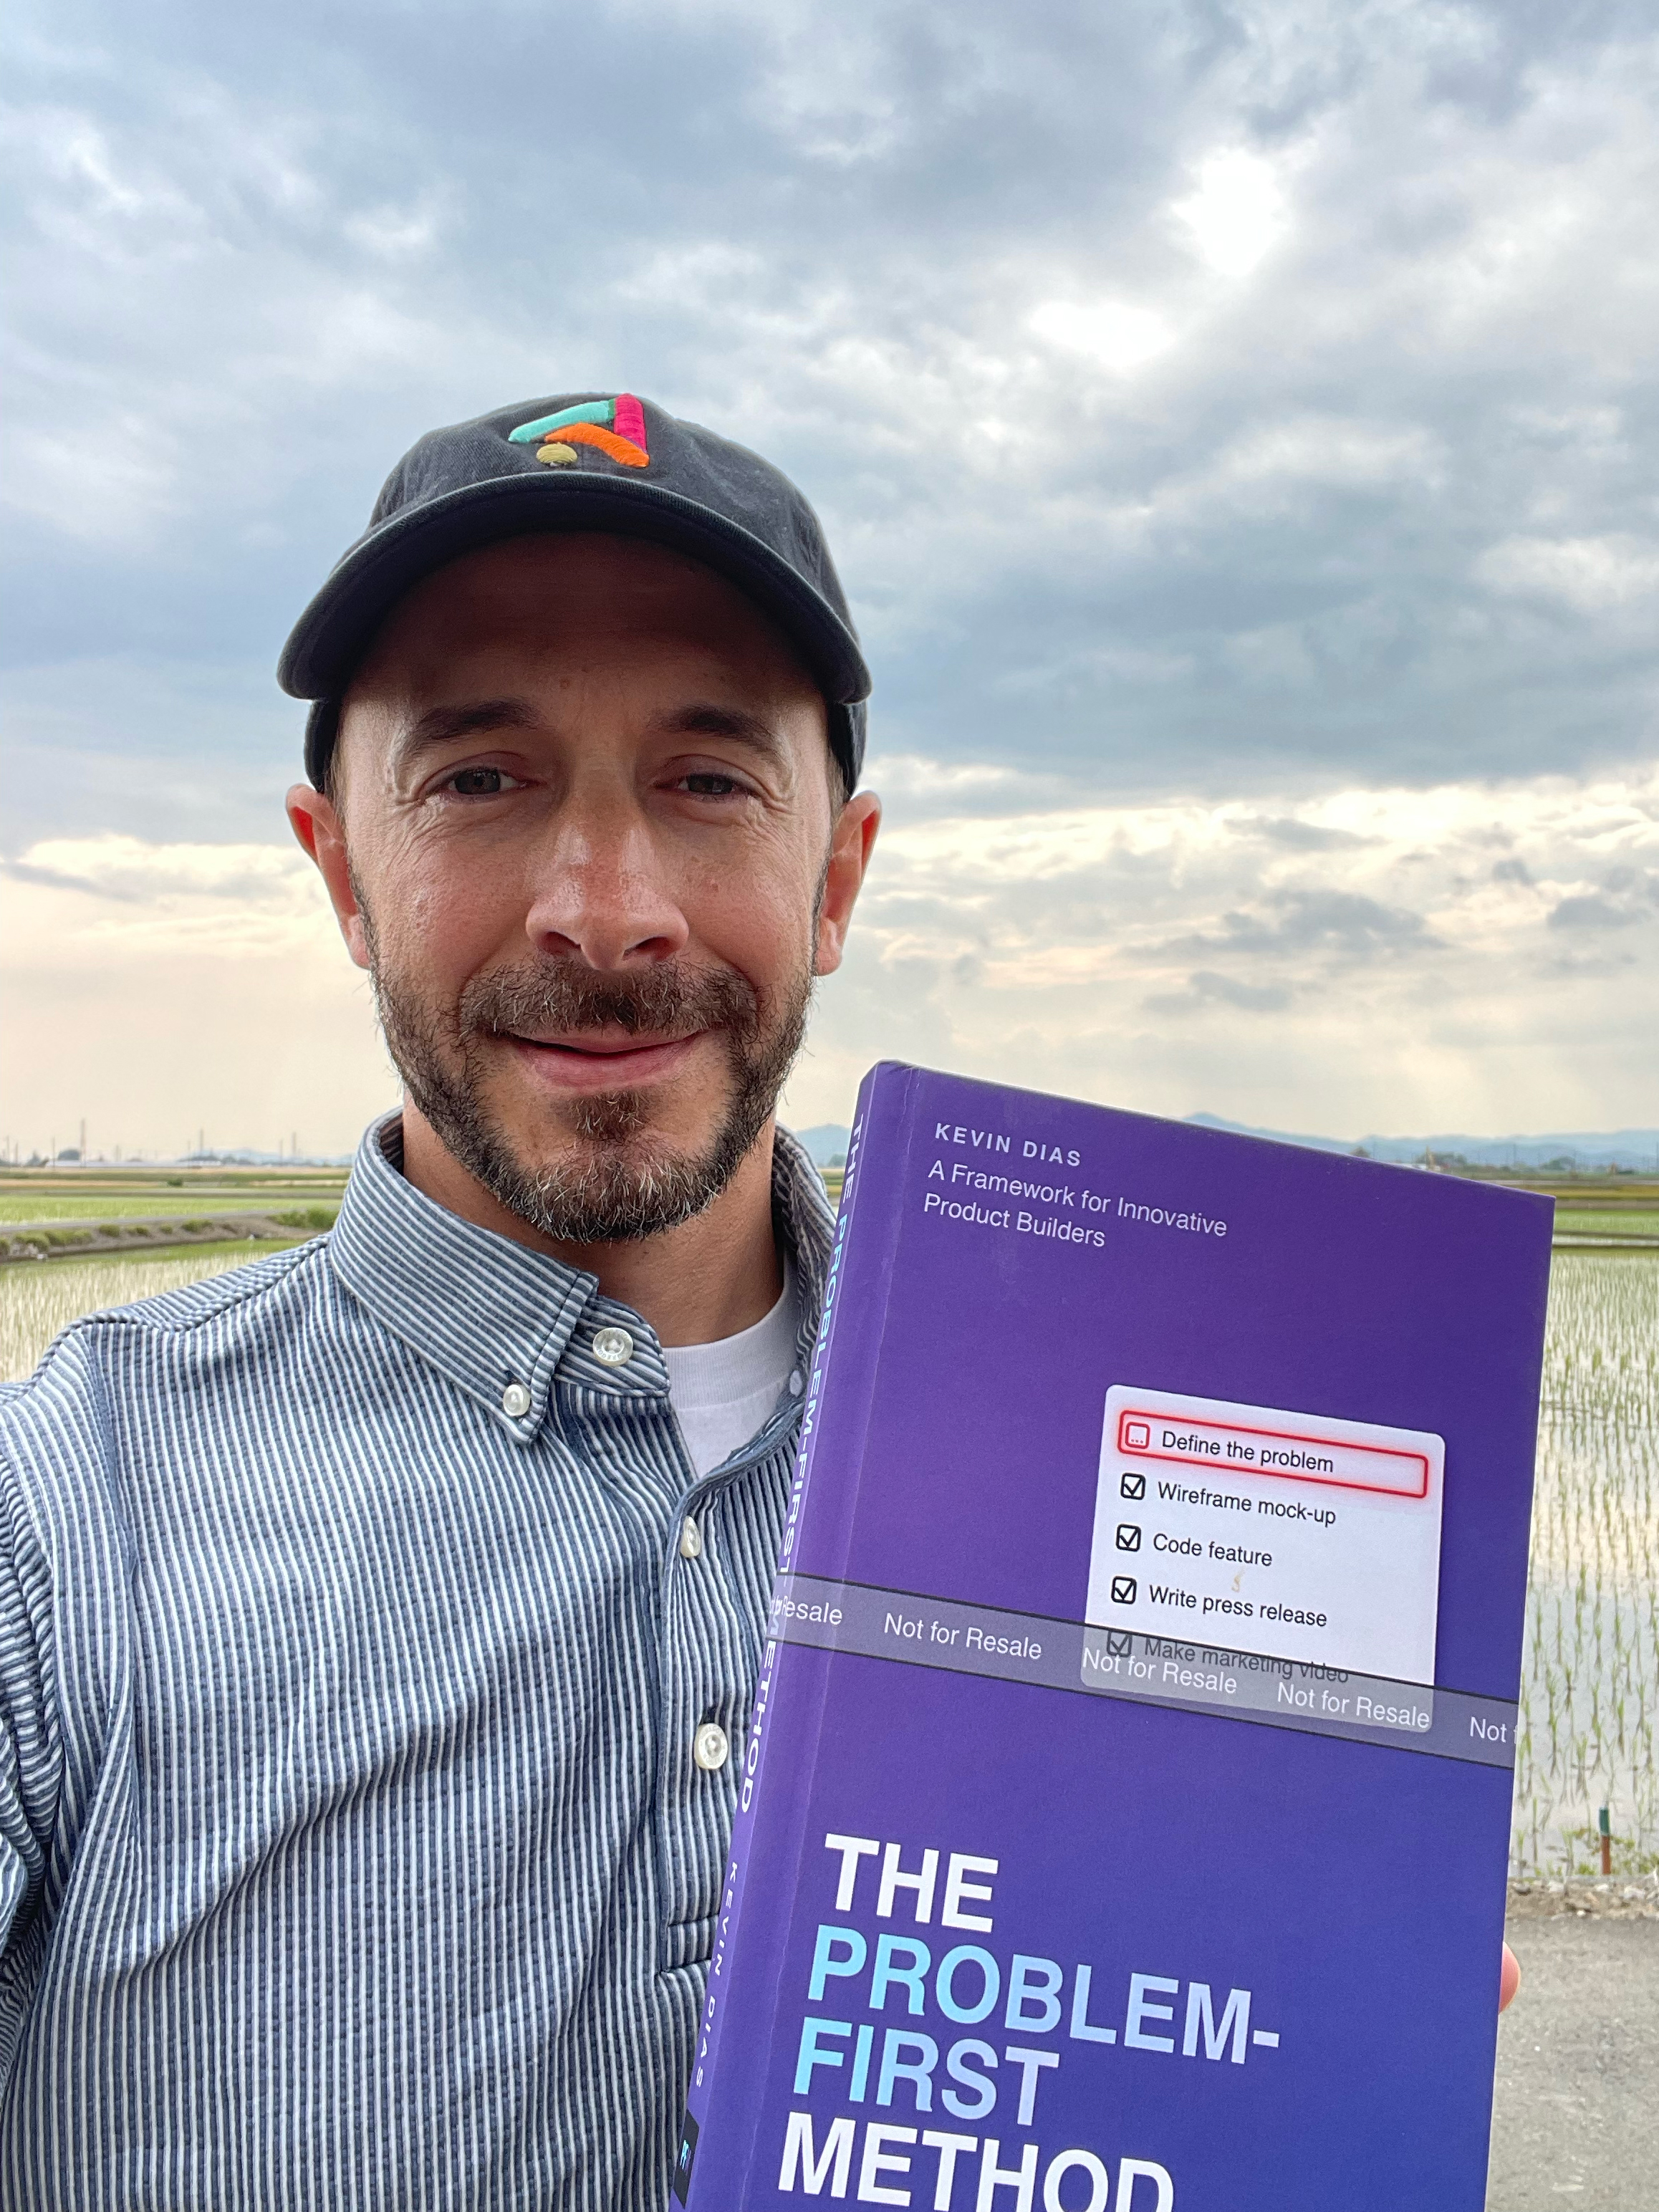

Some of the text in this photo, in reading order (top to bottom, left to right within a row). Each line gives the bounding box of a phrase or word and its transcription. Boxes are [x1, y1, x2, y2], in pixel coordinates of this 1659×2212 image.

[843, 1113, 863, 1204] THE
[935, 1122, 1081, 1167] KEVIN DIAS
[924, 1193, 1106, 1248] Product Builders
[928, 1160, 1228, 1238] A Framework for Innovative
[1162, 1430, 1334, 1472] Define the problem
[1158, 1481, 1337, 1528] Wireframe mock-up
[1153, 1533, 1273, 1567] Code feature
[1149, 1585, 1328, 1627] Write press release
[884, 1612, 1043, 1660] Not for Resale
[1082, 1647, 1238, 1695] Not for Resale
[1145, 1638, 1350, 1683] Make marketing video
[1277, 1681, 1430, 1729] Not for Resale
[1469, 1716, 1507, 1744] Not
[824, 1832, 999, 1933] THE
[695, 1861, 739, 2088] KEVIN DIAS
[807, 1924, 1281, 2065] PROBLEM-
[792, 2016, 1060, 2127] FIRST
[778, 2111, 1175, 2212] METHOD
